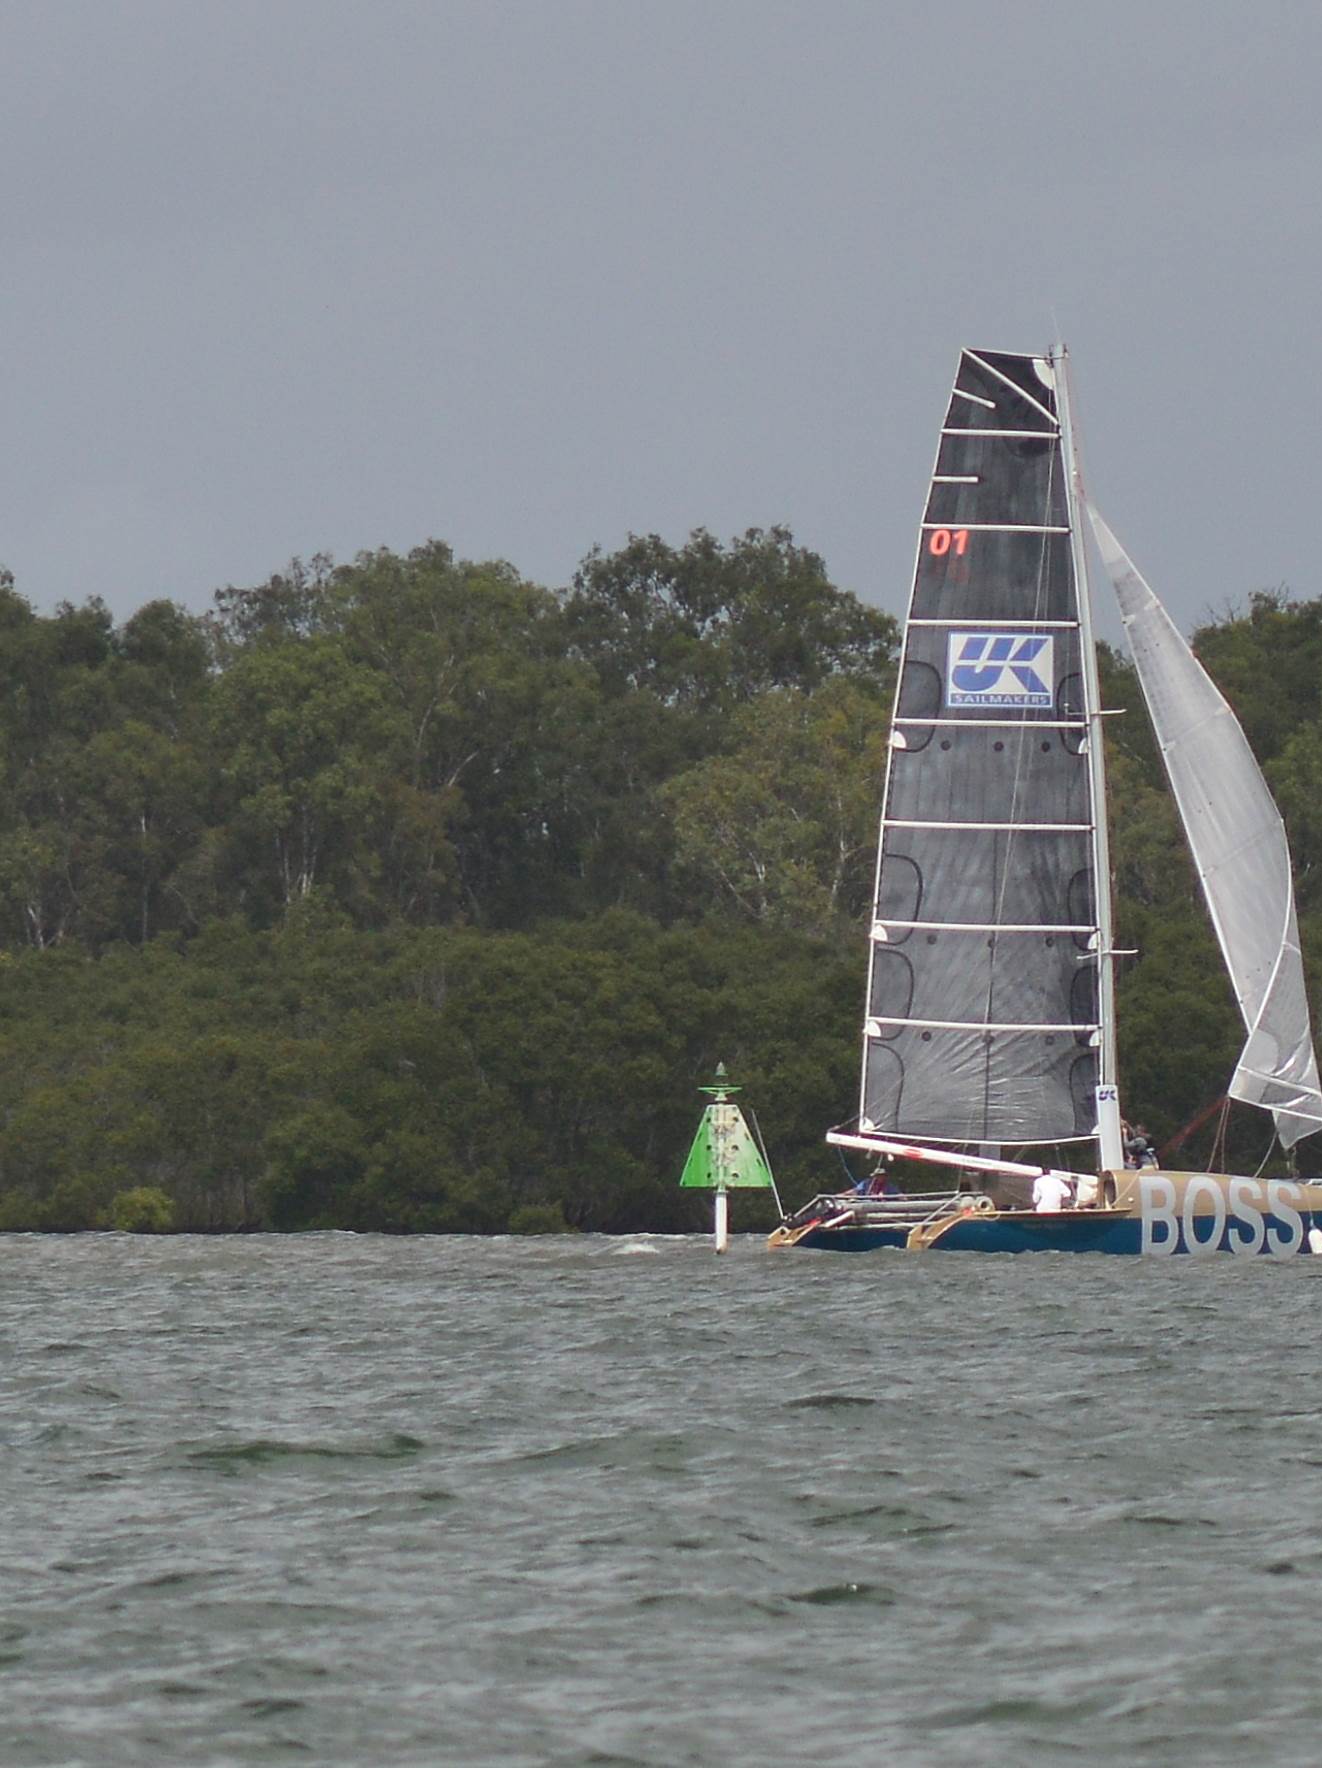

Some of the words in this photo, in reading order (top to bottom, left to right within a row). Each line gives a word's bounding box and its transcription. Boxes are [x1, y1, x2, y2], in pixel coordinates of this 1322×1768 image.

[929, 530, 970, 556] 01
[951, 637, 1049, 693] UK
[955, 694, 1047, 705] SAILMAKERS
[1139, 1175, 1304, 1259] BOSS
